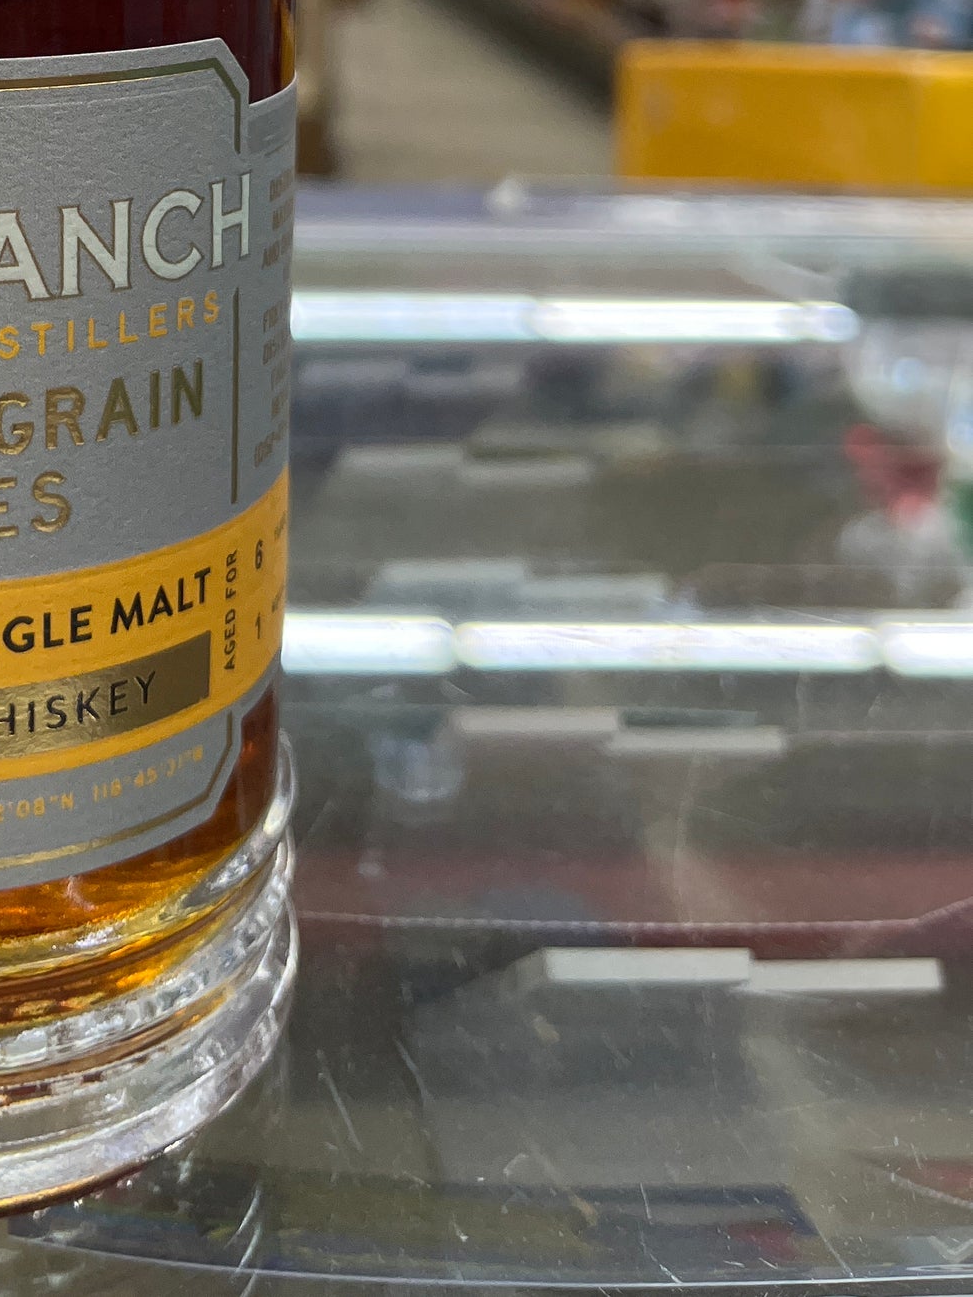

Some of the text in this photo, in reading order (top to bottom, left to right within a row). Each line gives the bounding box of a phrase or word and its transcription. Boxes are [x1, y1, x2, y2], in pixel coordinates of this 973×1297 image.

[254, 538, 264, 571] 6
[109, 566, 214, 635] MALT
[224, 549, 238, 671] AGED FOR
